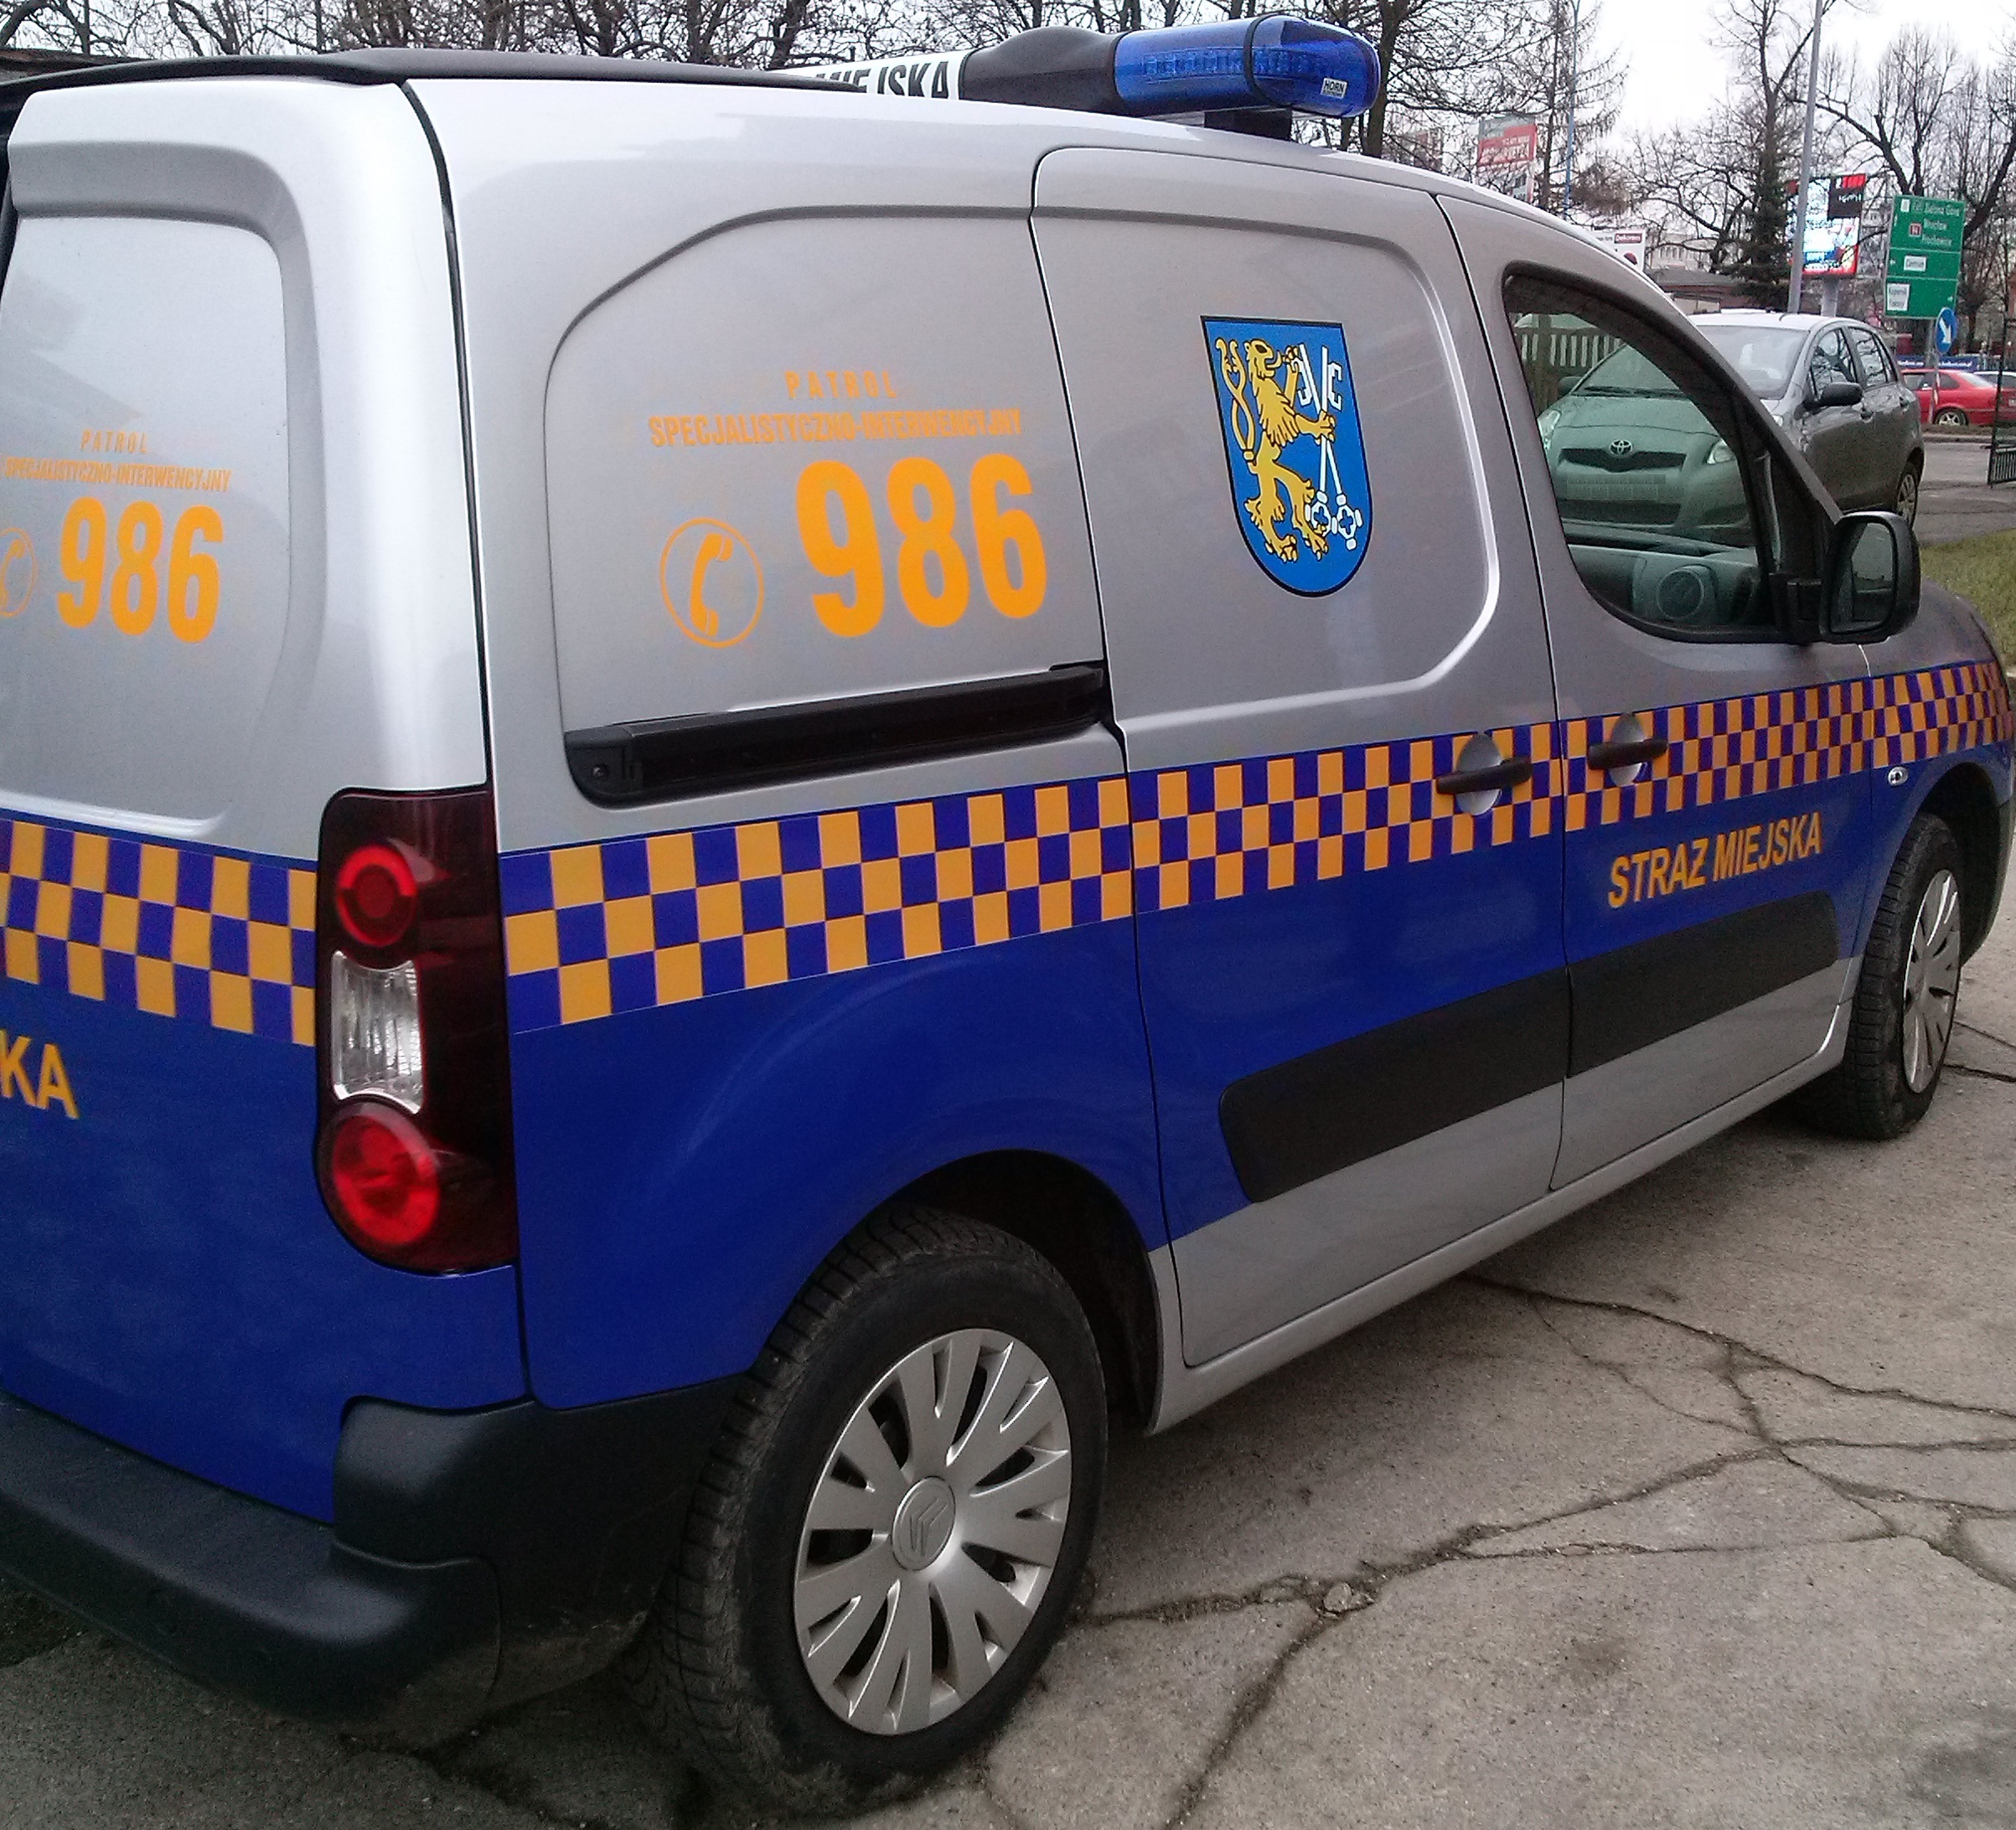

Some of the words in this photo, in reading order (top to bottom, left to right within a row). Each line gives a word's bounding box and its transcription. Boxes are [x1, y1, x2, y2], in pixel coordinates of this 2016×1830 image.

[1324, 80, 1346, 92] HORN
[784, 370, 898, 399] PATROL
[80, 429, 149, 454] PATROL
[56, 496, 225, 644] 986
[796, 453, 1047, 638] 986
[1712, 810, 1823, 881] MIEJSKA
